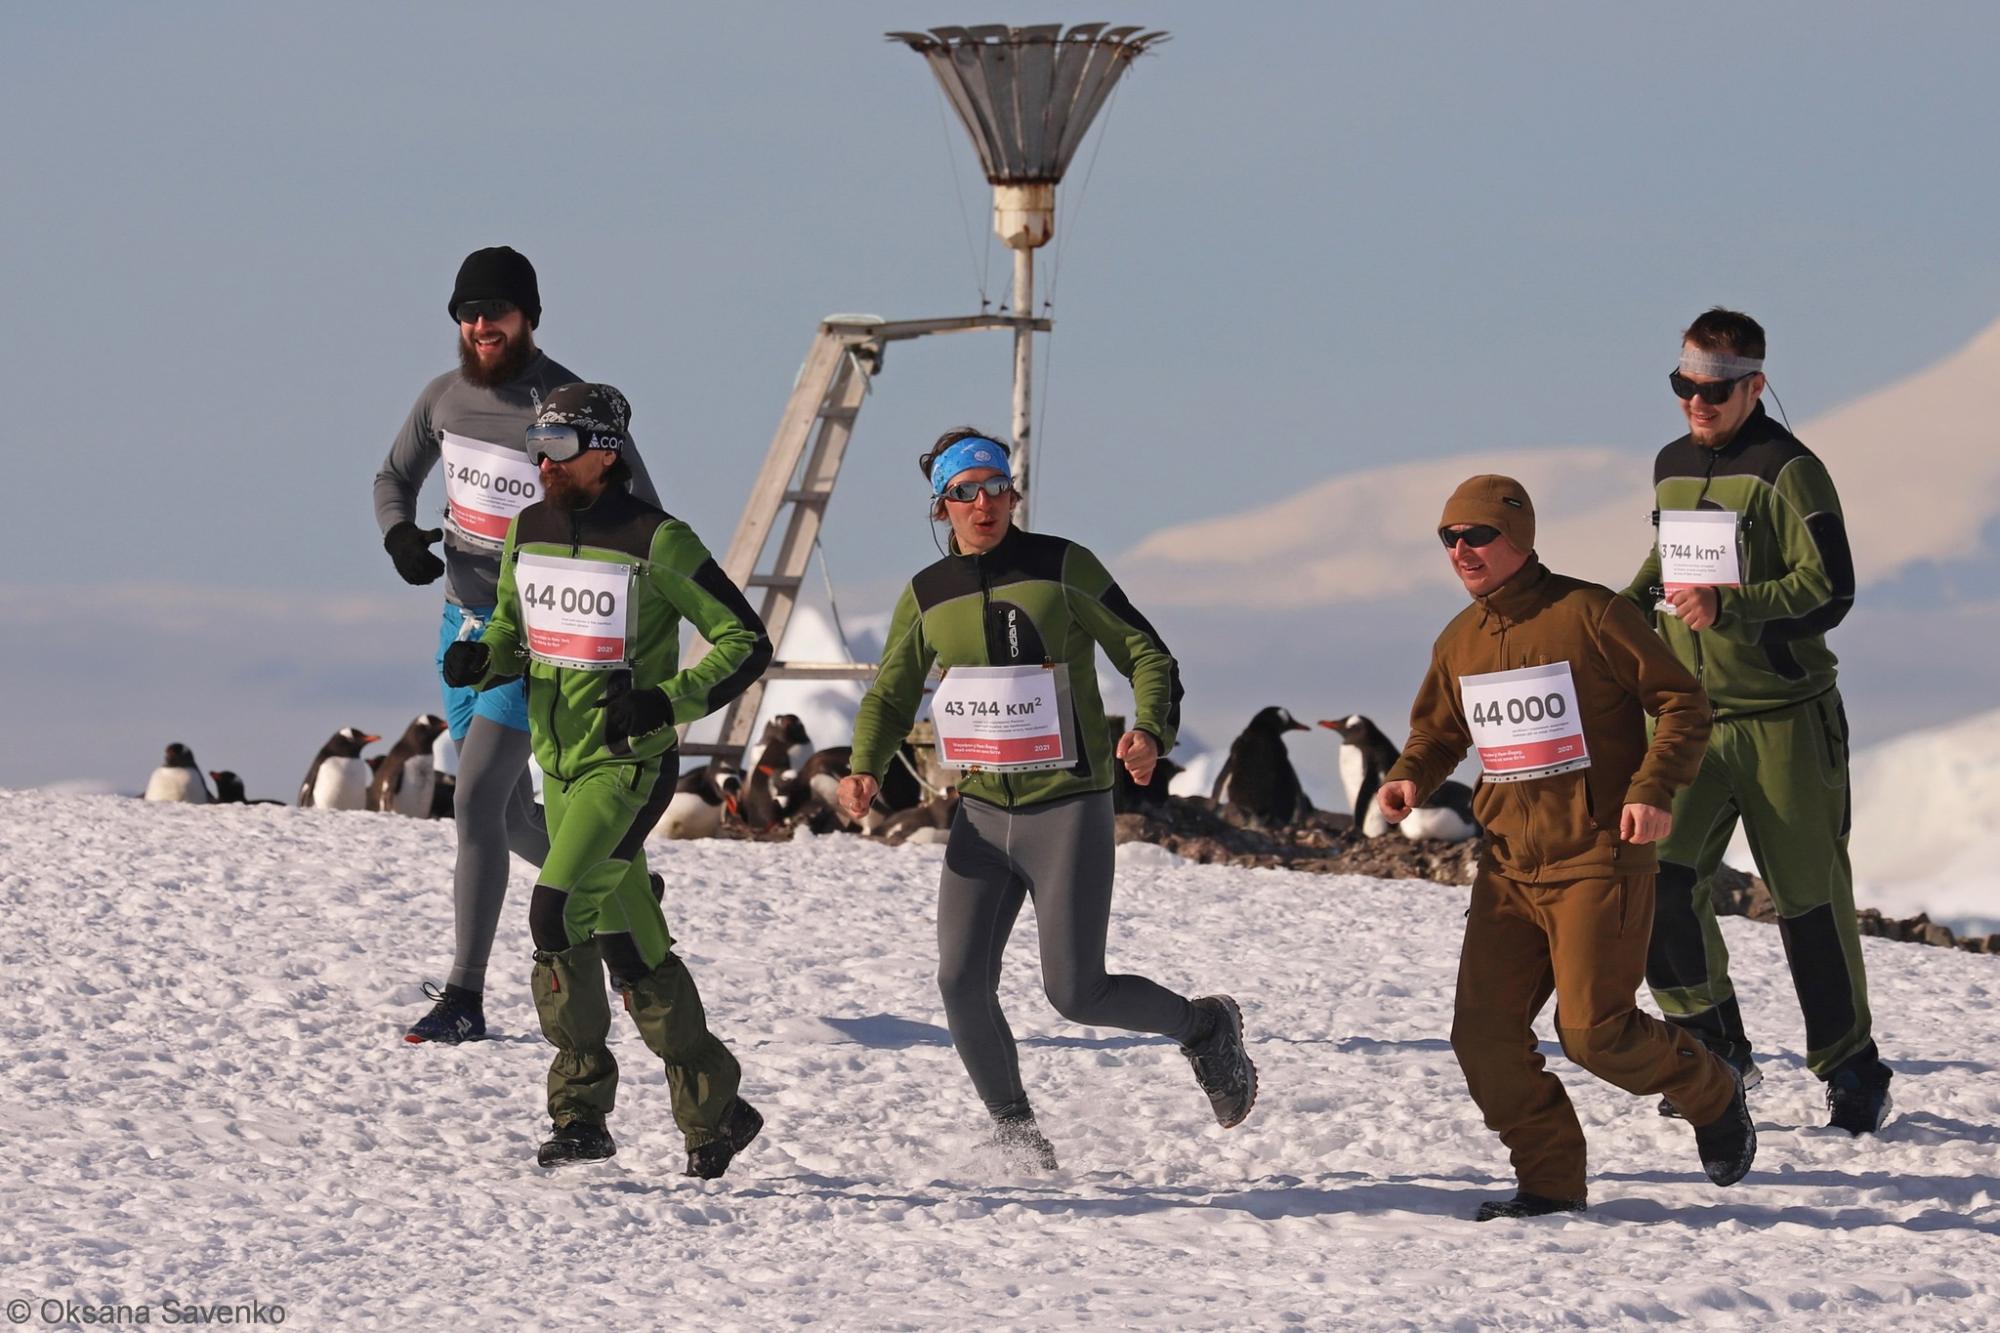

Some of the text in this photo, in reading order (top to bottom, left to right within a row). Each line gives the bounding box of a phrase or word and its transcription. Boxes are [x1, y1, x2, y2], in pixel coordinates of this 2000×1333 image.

[447, 462, 536, 499] 3 400 000
[1670, 544, 1692, 560] 744
[524, 583, 616, 618] 44 000
[944, 701, 965, 716] 43
[968, 701, 1000, 716] 744
[1473, 692, 1566, 727] 44 000
[1034, 744, 1050, 752] 2021
